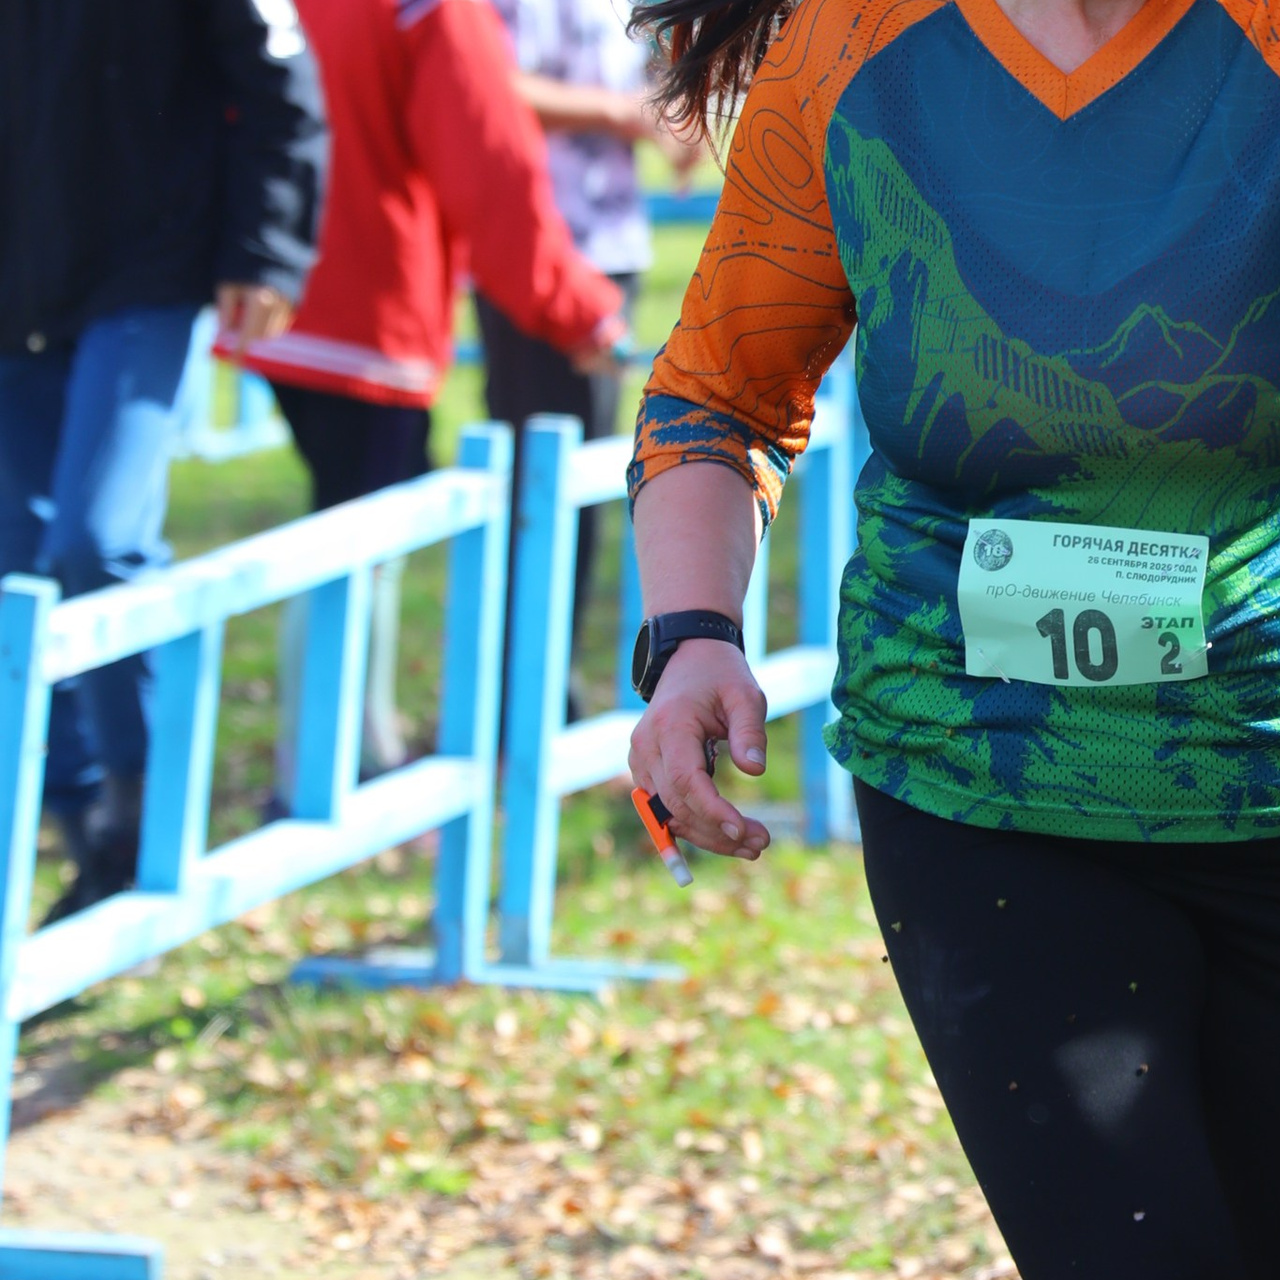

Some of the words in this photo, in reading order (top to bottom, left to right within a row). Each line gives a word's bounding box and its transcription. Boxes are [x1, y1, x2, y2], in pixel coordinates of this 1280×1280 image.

[1053, 534, 1124, 553] ГОРЯЧАЯ
[1127, 540, 1200, 559] ДЕСЯТКА
[1087, 556, 1099, 565] 26
[1101, 557, 1148, 569] СЕНТЯБРЯ
[1126, 572, 1196, 584] СЛЮДОРУДНИК
[986, 583, 1096, 602] прО-движение
[1101, 590, 1181, 607] Челябинск
[1140, 617, 1194, 630] ЭТАП
[1036, 608, 1119, 682] 10
[1157, 631, 1183, 675] 2
